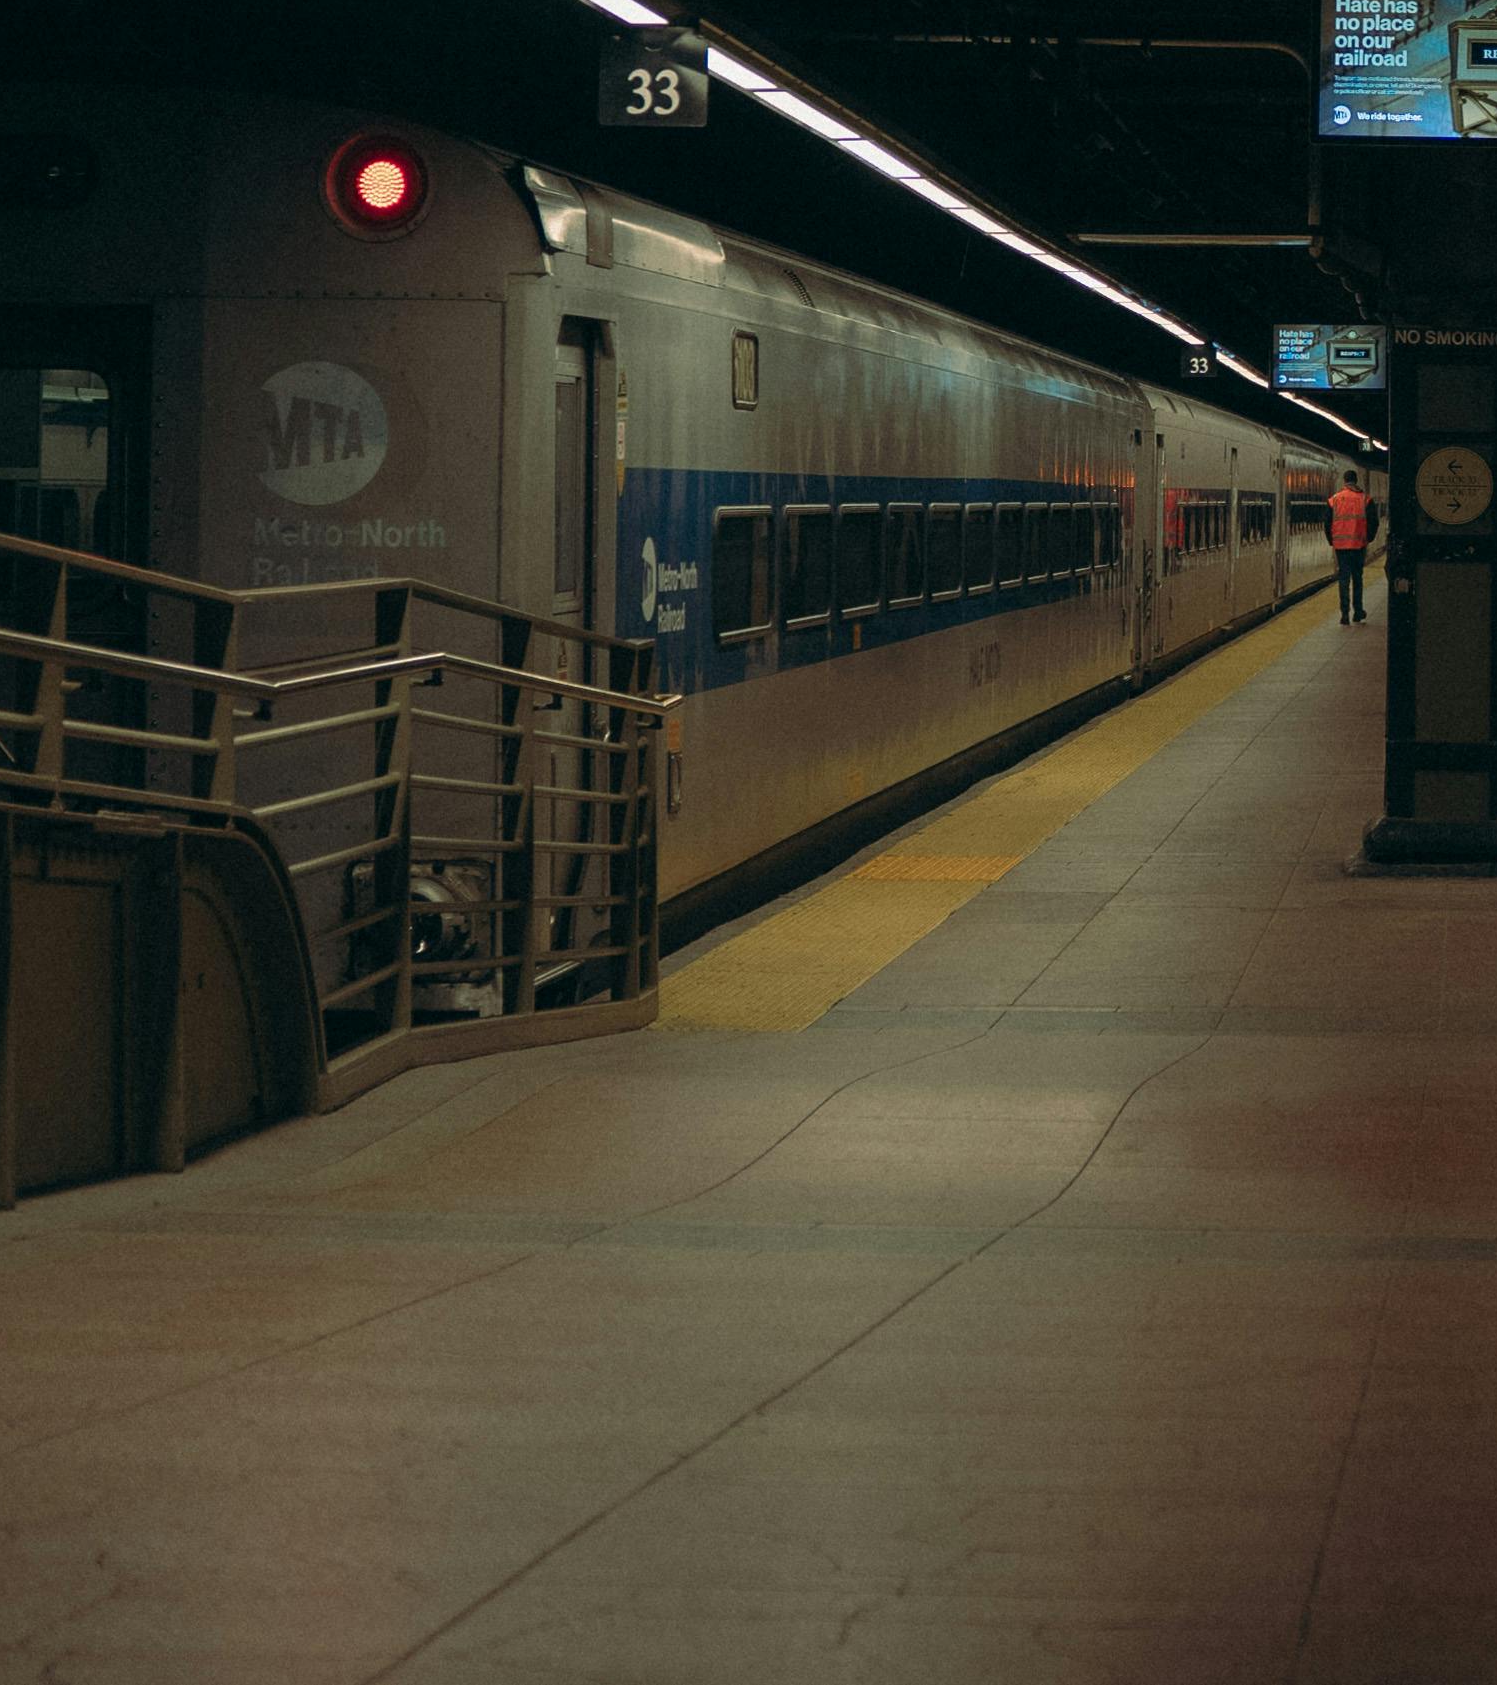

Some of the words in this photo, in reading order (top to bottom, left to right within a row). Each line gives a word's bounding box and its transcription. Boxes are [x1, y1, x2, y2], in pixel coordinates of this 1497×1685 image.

[1335, 16, 1360, 31] no
[1363, 14, 1415, 34] place
[1334, 34, 1359, 48] on
[1362, 35, 1395, 49] our
[1334, 49, 1408, 67] railroad
[625, 68, 680, 115] 33
[1357, 111, 1370, 120] We
[1371, 111, 1386, 120] ride
[1278, 330, 1298, 338] Hate
[1299, 330, 1314, 338] has
[1278, 338, 1290, 346] no
[1290, 337, 1313, 347] place
[1394, 330, 1420, 345] NO
[1278, 352, 1310, 360] railroad
[1190, 357, 1209, 374] 33
[257, 384, 371, 474] MTA
[657, 561, 699, 592] Metro-North
[657, 602, 686, 633] Railroad
